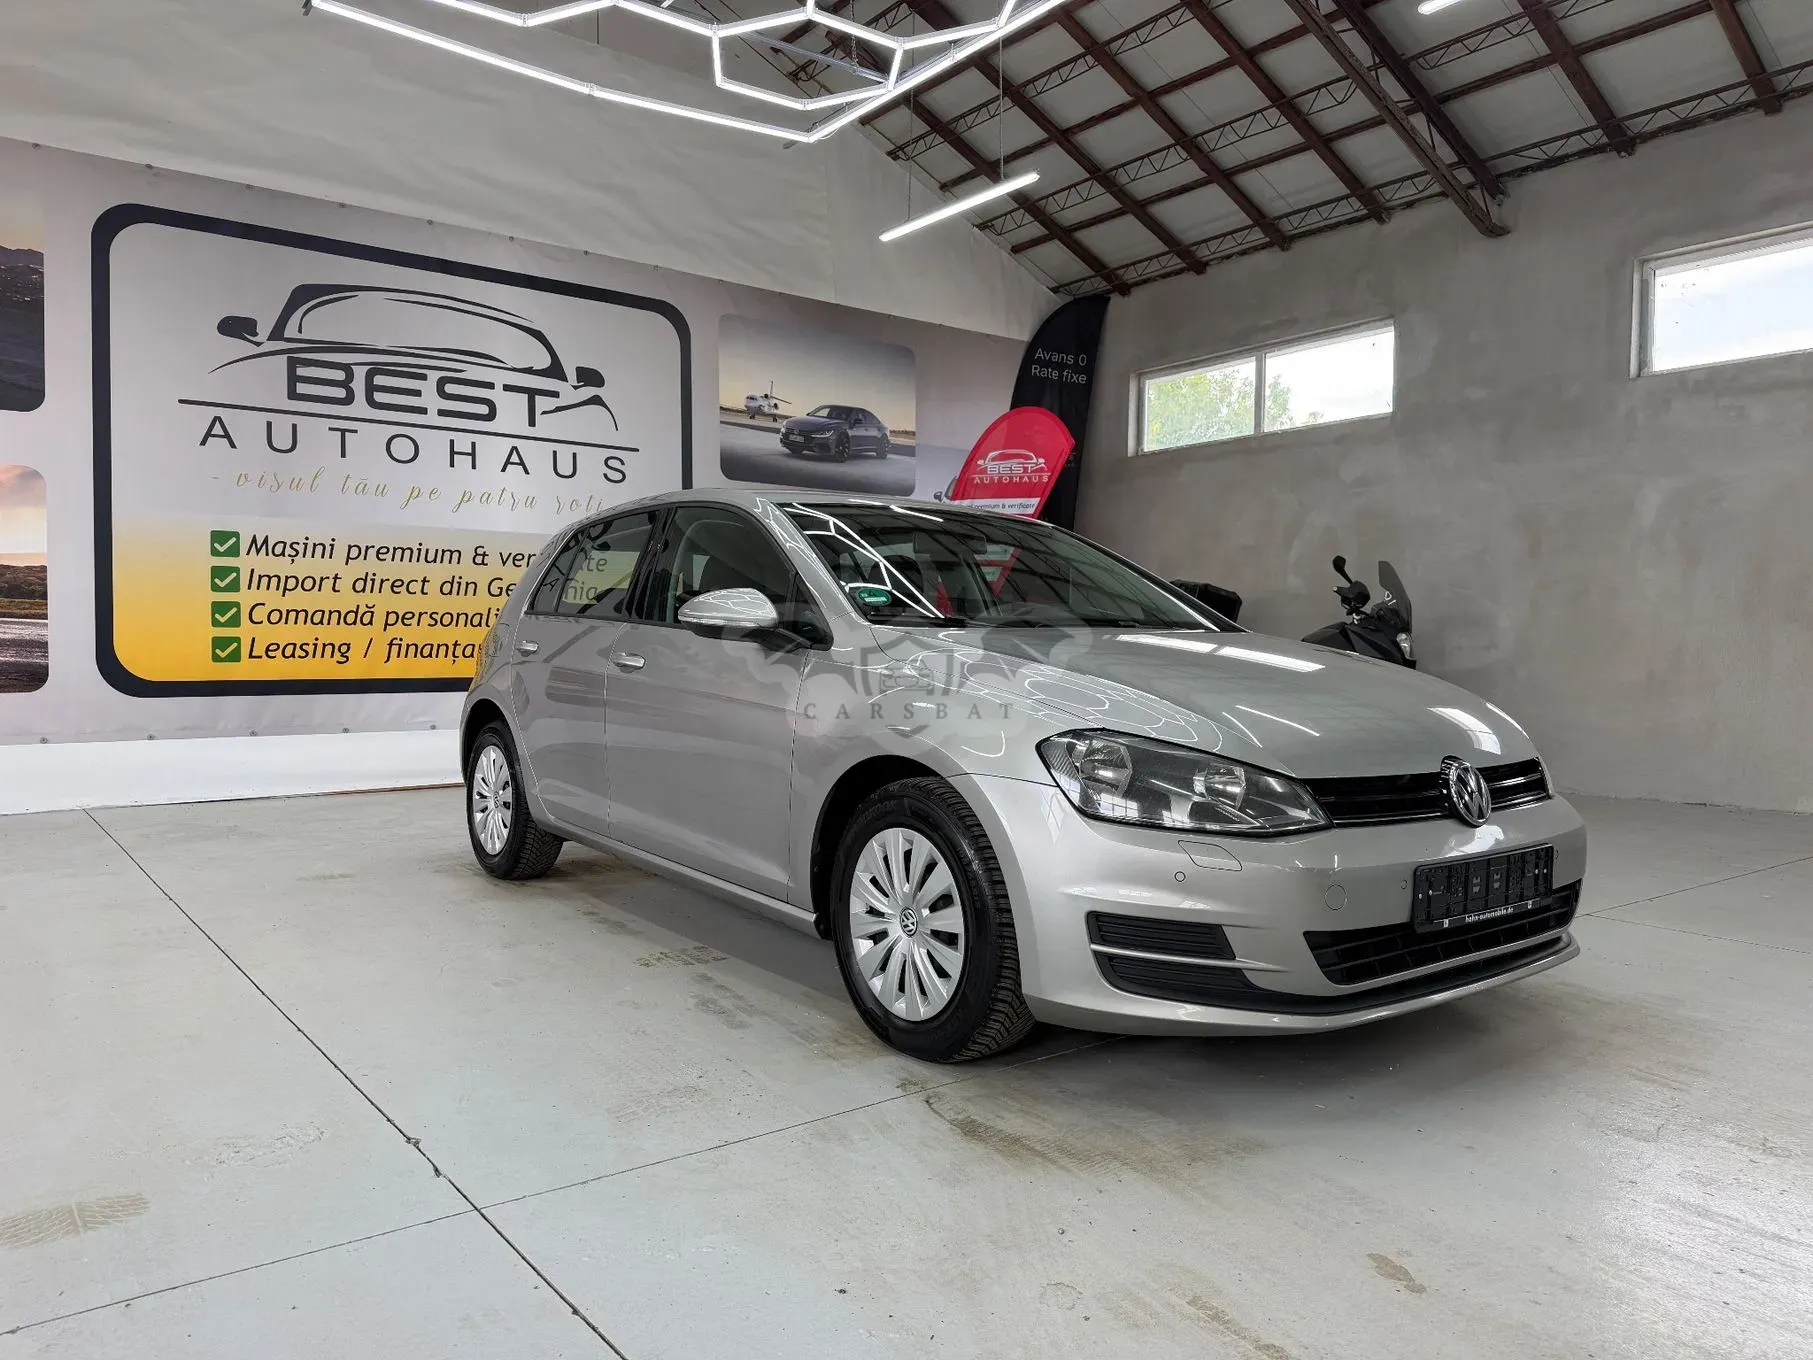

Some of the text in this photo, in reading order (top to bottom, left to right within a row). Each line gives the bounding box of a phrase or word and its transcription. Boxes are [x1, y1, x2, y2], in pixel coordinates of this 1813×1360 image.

[1034, 347, 1087, 367] Avans 0
[1031, 364, 1087, 385] Rate fixe
[287, 355, 560, 428] BEST
[199, 415, 628, 484] AUTOHAUS
[973, 474, 1049, 484] AUTOHAUS
[987, 464, 1037, 474] BEST
[400, 484, 441, 511] pe
[452, 486, 537, 514] patru
[1007, 502, 1035, 510] verificate
[246, 533, 336, 565] Mașini
[344, 542, 462, 567] premium
[472, 545, 489, 567] &
[247, 567, 342, 598] Import
[352, 571, 430, 597] direct
[440, 575, 477, 597] din
[248, 602, 500, 632] Comandă personali
[248, 636, 482, 667] Leasing / finanța
